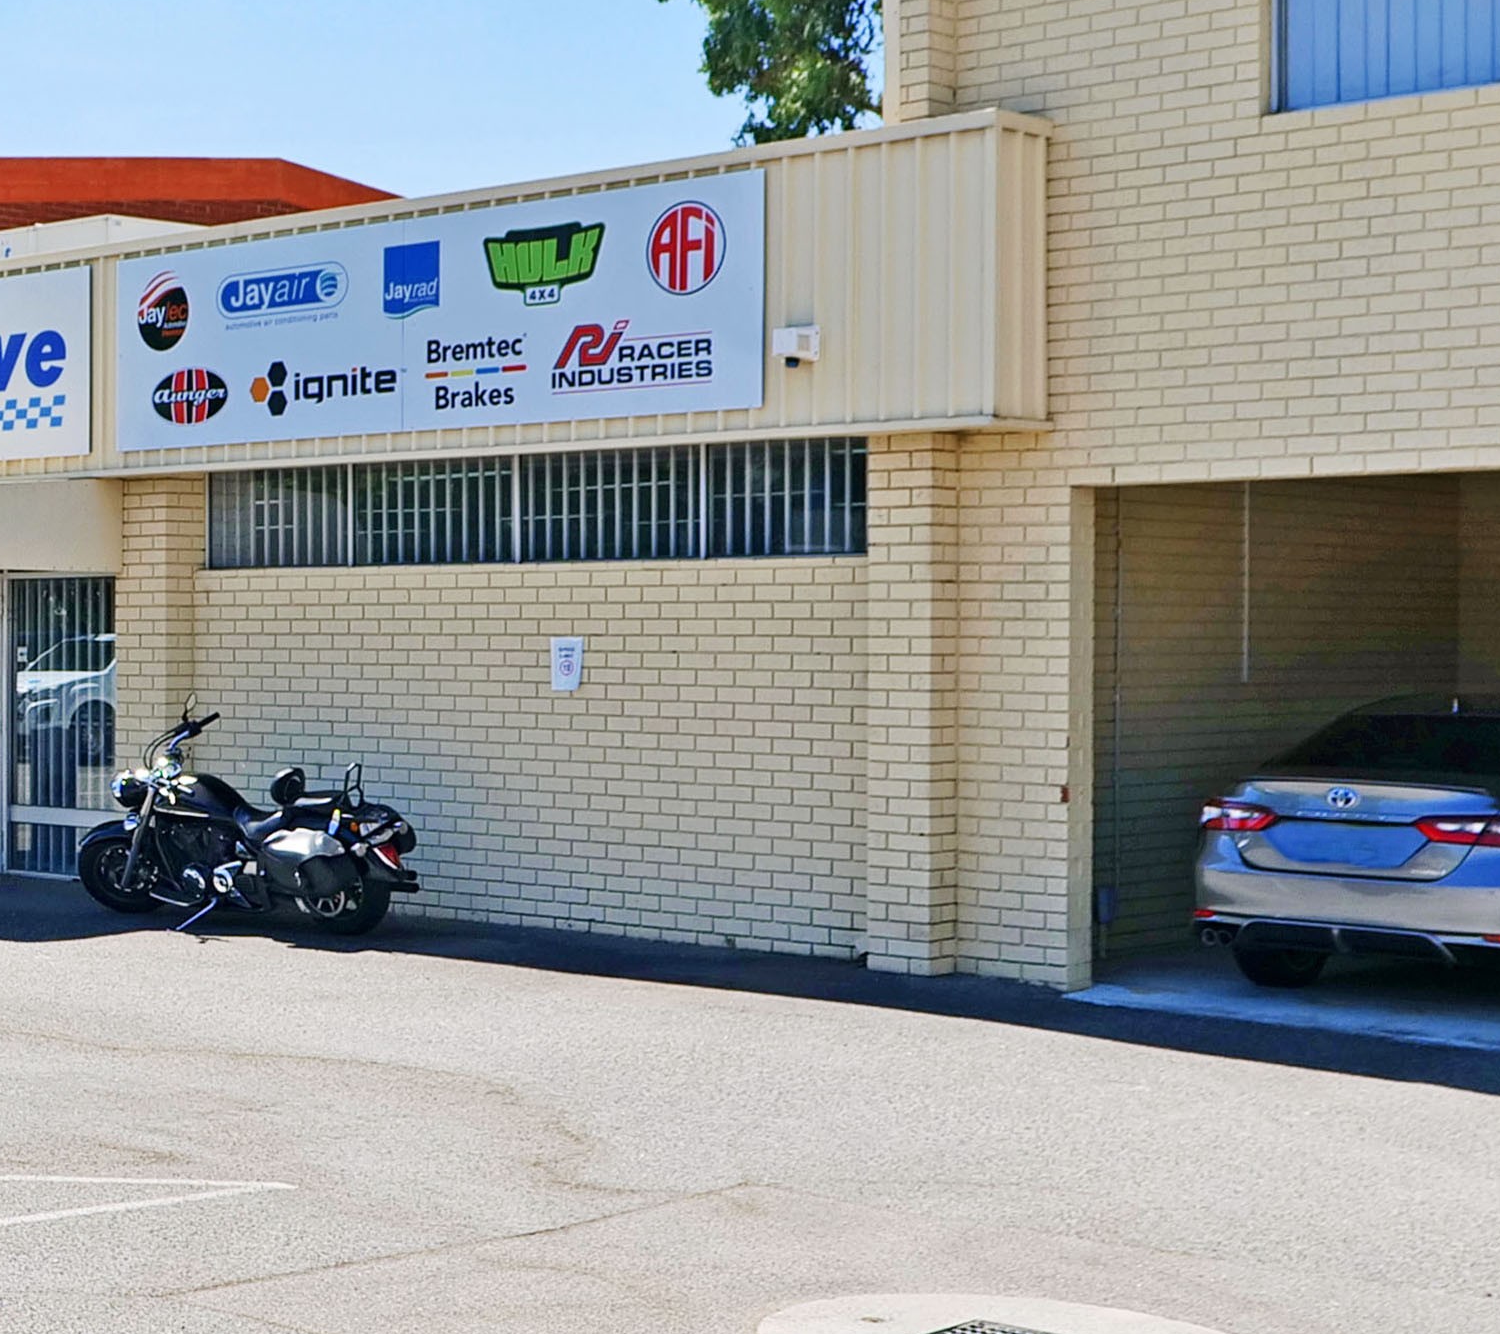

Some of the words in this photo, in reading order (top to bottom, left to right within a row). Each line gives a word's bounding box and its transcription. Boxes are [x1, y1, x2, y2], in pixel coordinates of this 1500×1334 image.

[487, 226, 601, 284] HULK
[230, 272, 310, 309] Jayair
[384, 277, 438, 303] Jayrad
[426, 336, 523, 364] Bremtec
[618, 338, 712, 363] RACER
[294, 366, 397, 404] ignite
[551, 359, 713, 390] INDUSTRIES
[435, 380, 515, 410] Brakes
